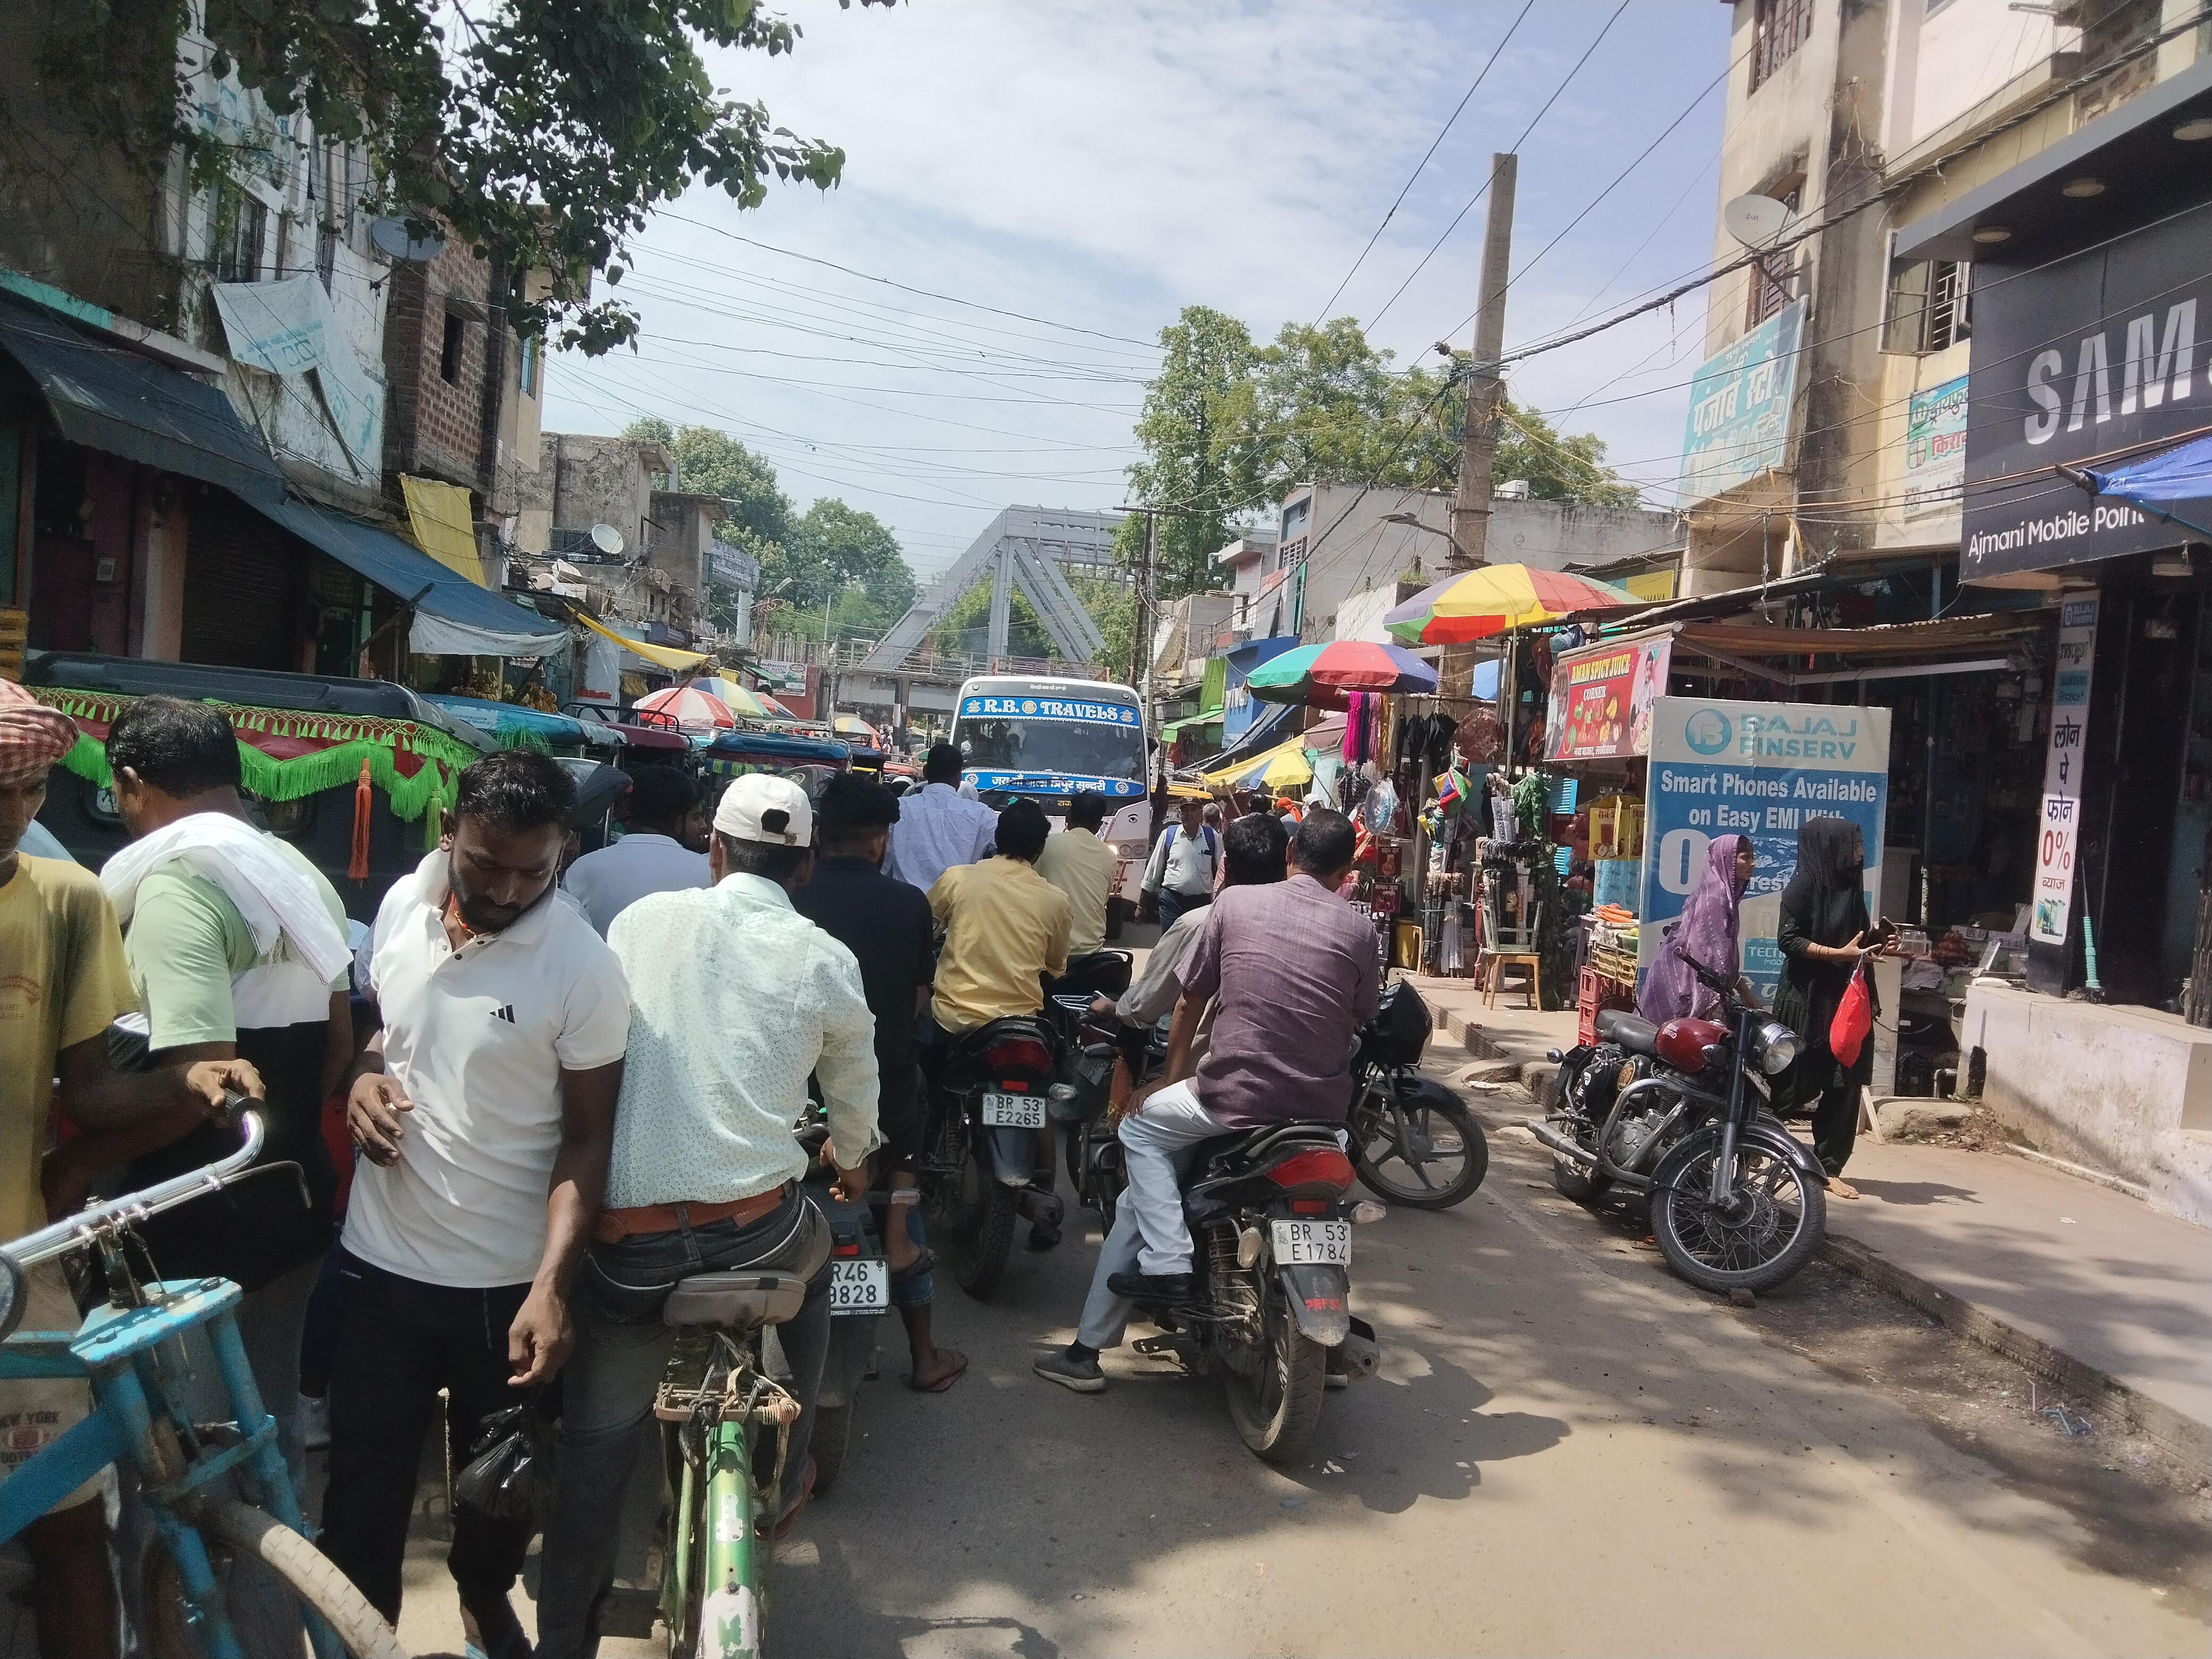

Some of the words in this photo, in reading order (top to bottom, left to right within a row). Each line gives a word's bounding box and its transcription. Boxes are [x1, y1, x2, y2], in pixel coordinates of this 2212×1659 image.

[2024, 298, 2212, 445] SAM
[1693, 378, 1743, 438] पंजाब
[1746, 349, 1788, 410] स्टोर
[1968, 520, 2024, 563] Ajmani
[2028, 510, 2090, 544] Mobile
[1571, 663, 1590, 684] AMAN
[1589, 658, 1610, 681] SPICY
[1610, 653, 1632, 677] JUICE
[1583, 685, 1606, 701] CORNER
[984, 699, 1020, 714] R.B.
[1040, 701, 1118, 720] TRAVELS
[1741, 712, 1857, 738] BAJAJ
[2055, 715, 2082, 748] लोन
[1739, 736, 1857, 760] FINSERV
[2059, 752, 2069, 784] पे
[1661, 769, 1716, 794] Smart
[1723, 773, 1788, 798] Phones
[1794, 777, 1876, 802] Available
[1689, 808, 1711, 825] on
[1717, 805, 1761, 833] Easy
[1766, 807, 1799, 830] EMI
[2048, 789, 2074, 823] फोन
[2043, 830, 2071, 870] 0%
[1748, 875, 1790, 892] rest
[2042, 877, 2066, 891] ब्याज
[1748, 946, 1785, 958] TECN
[996, 1096, 1014, 1110] BR
[1023, 1099, 1040, 1111] 53
[996, 1110, 1041, 1126] E2265
[1290, 1224, 1312, 1241] BR
[1325, 1224, 1346, 1241] 53
[1292, 1243, 1346, 1261] E1784
